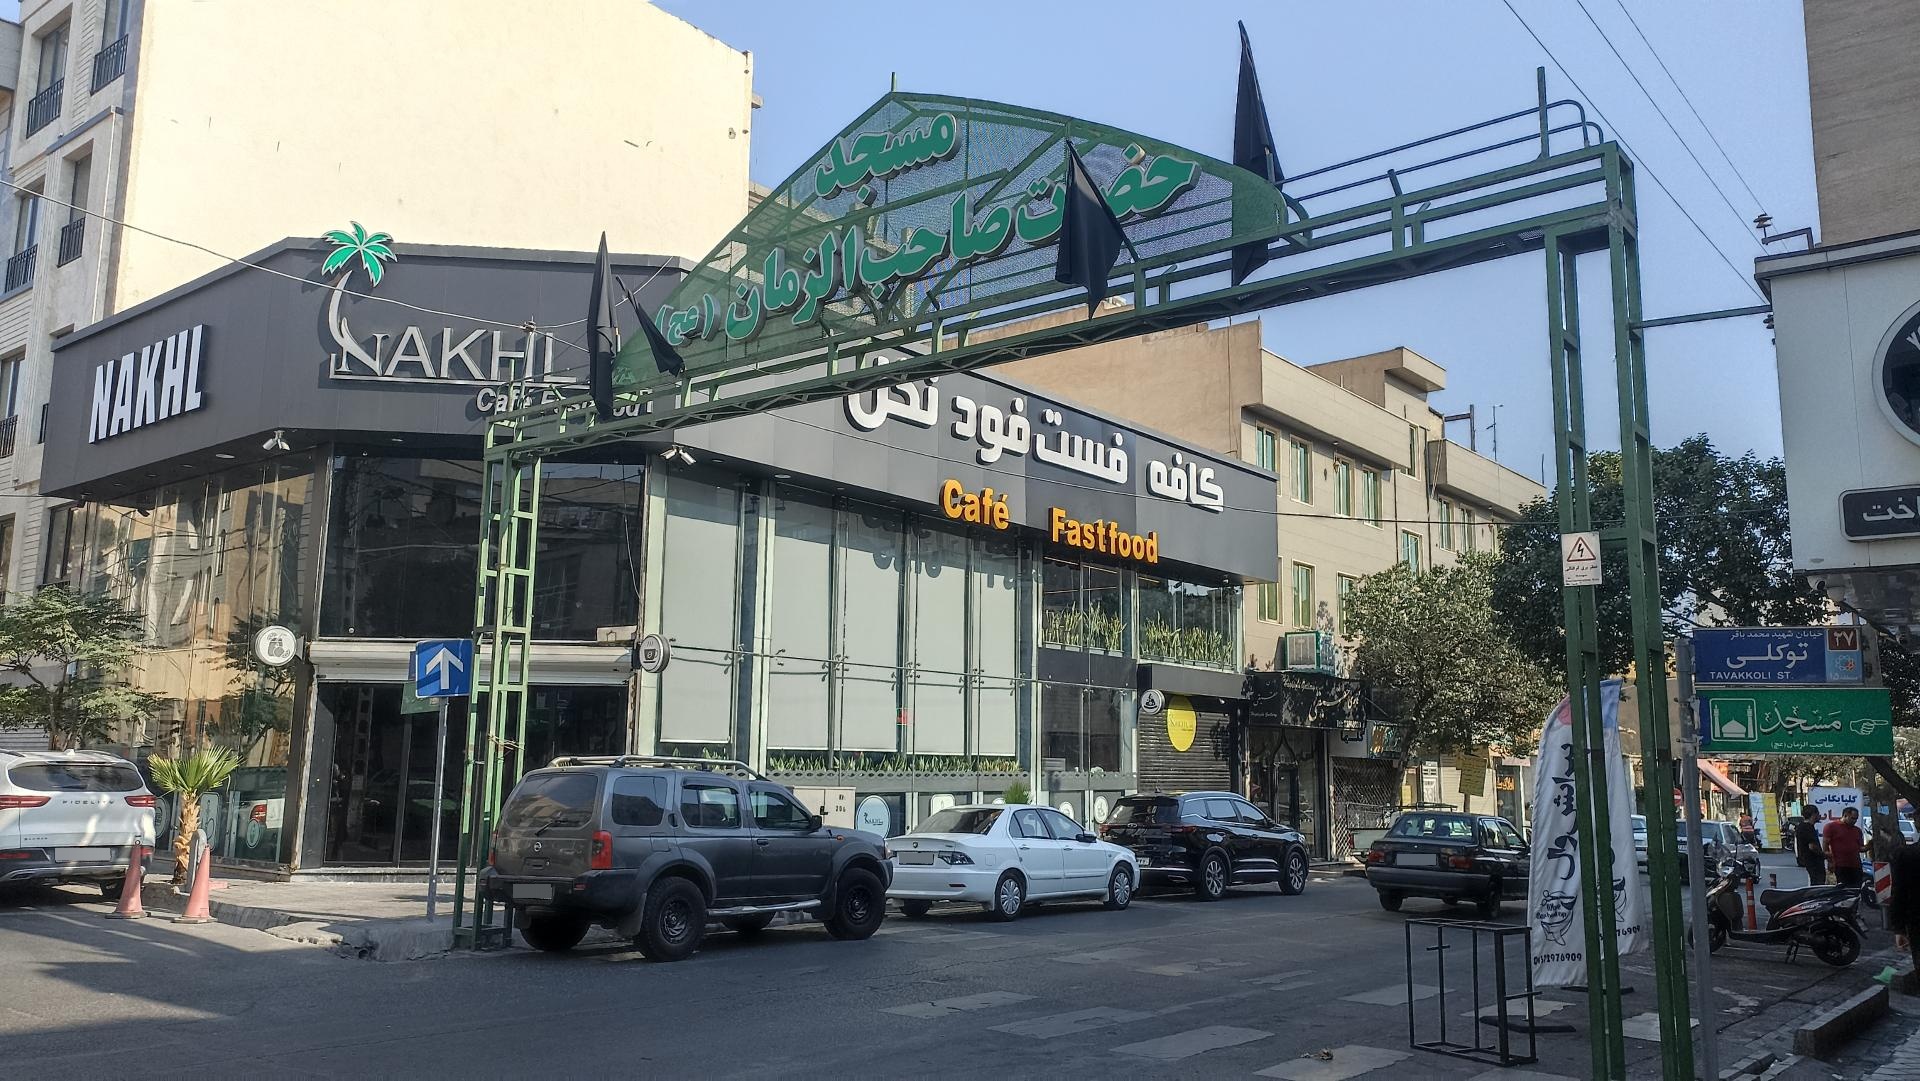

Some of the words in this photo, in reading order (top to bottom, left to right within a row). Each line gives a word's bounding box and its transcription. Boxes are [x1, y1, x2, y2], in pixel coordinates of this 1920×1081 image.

[815, 112, 958, 202] مسجد
[860, 190, 1013, 299] صاحب
[726, 225, 859, 340] الزمان
[334, 317, 577, 383] NAKHL
[89, 325, 204, 444] NAKHL
[951, 396, 1031, 463] فود
[1033, 408, 1128, 485] فست
[941, 479, 1010, 530] Café
[1147, 453, 1225, 513] کافه
[1726, 642, 1809, 669] توکلی
[1730, 630, 1745, 640] باقر
[1771, 630, 1793, 639] شهید
[1709, 671, 1771, 680] TAVAKKOLI
[1777, 671, 1794, 680] ST.
[1809, 741, 1834, 750] صاحب
